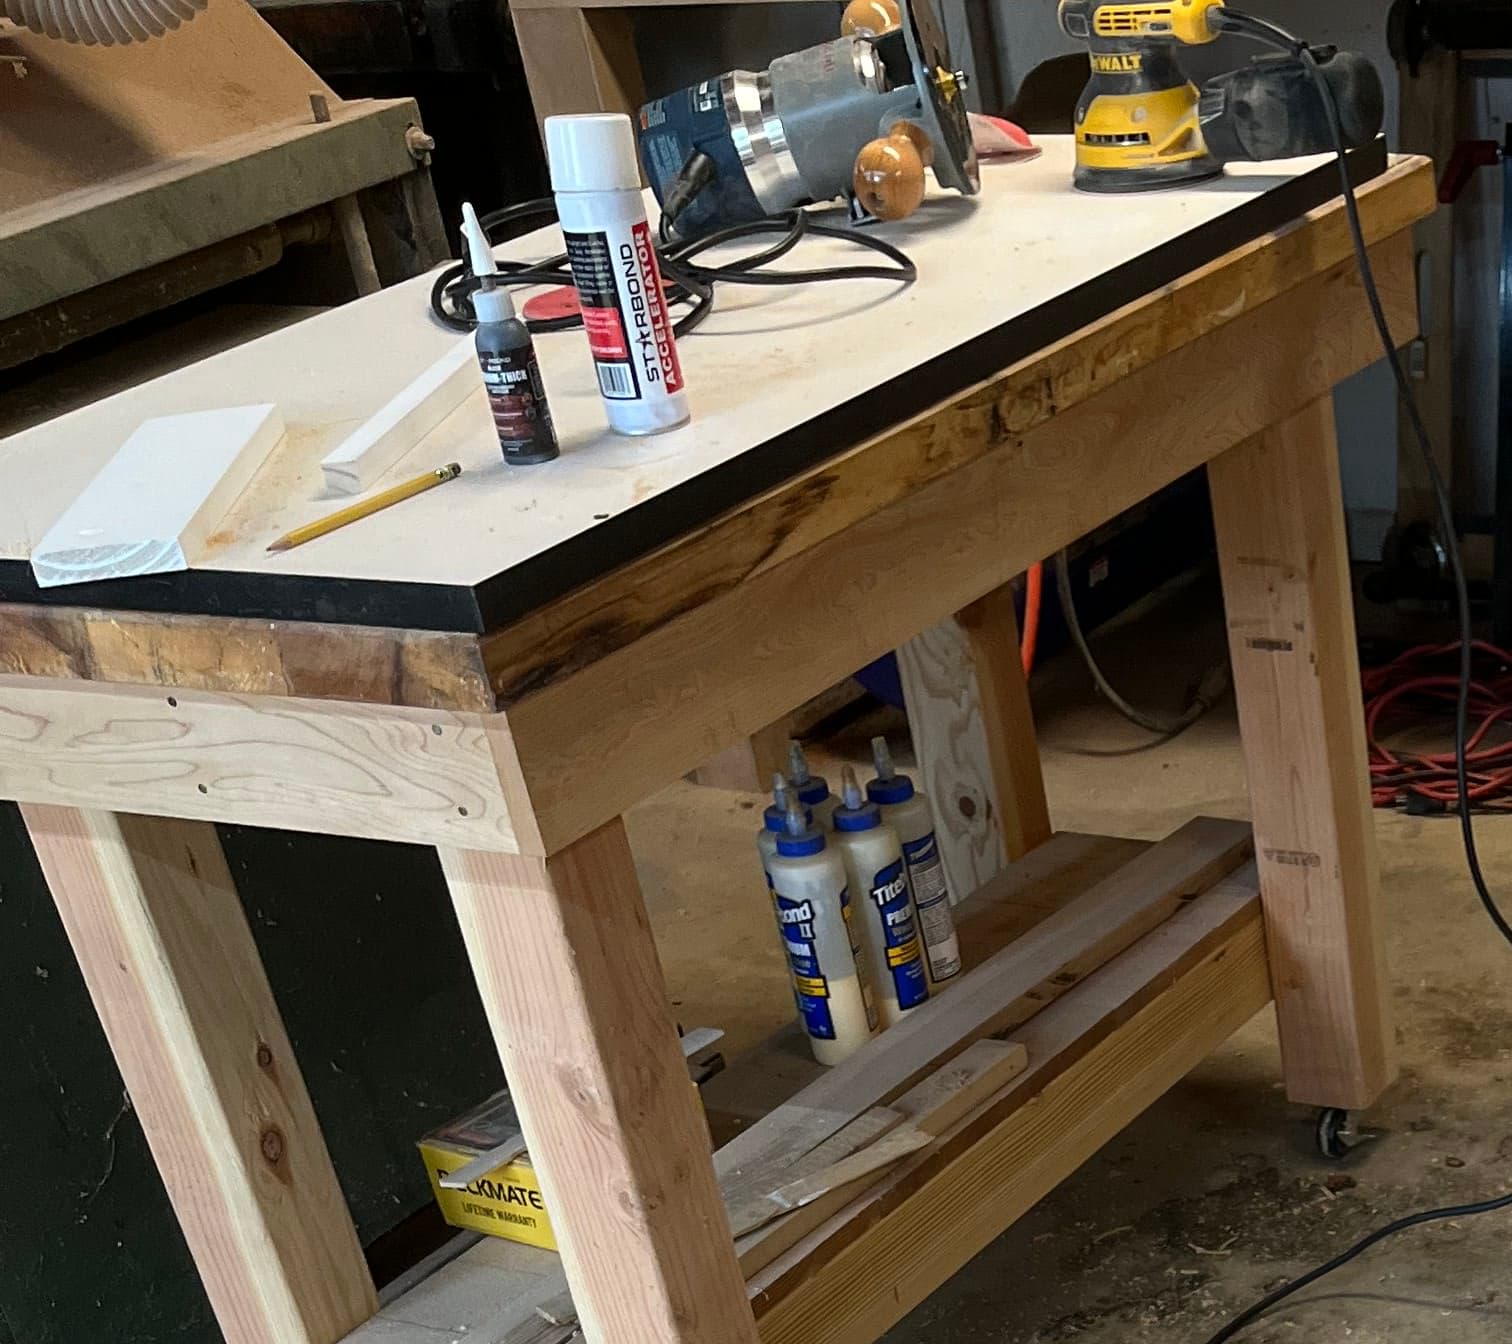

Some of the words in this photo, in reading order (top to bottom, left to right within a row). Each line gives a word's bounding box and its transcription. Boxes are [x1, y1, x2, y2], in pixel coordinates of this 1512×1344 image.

[635, 229, 677, 386] ACCELERATOR
[437, 1168, 544, 1210] CKMATE
[462, 1201, 497, 1219] LIFETIME
[496, 1209, 537, 1229] WARRANTY
